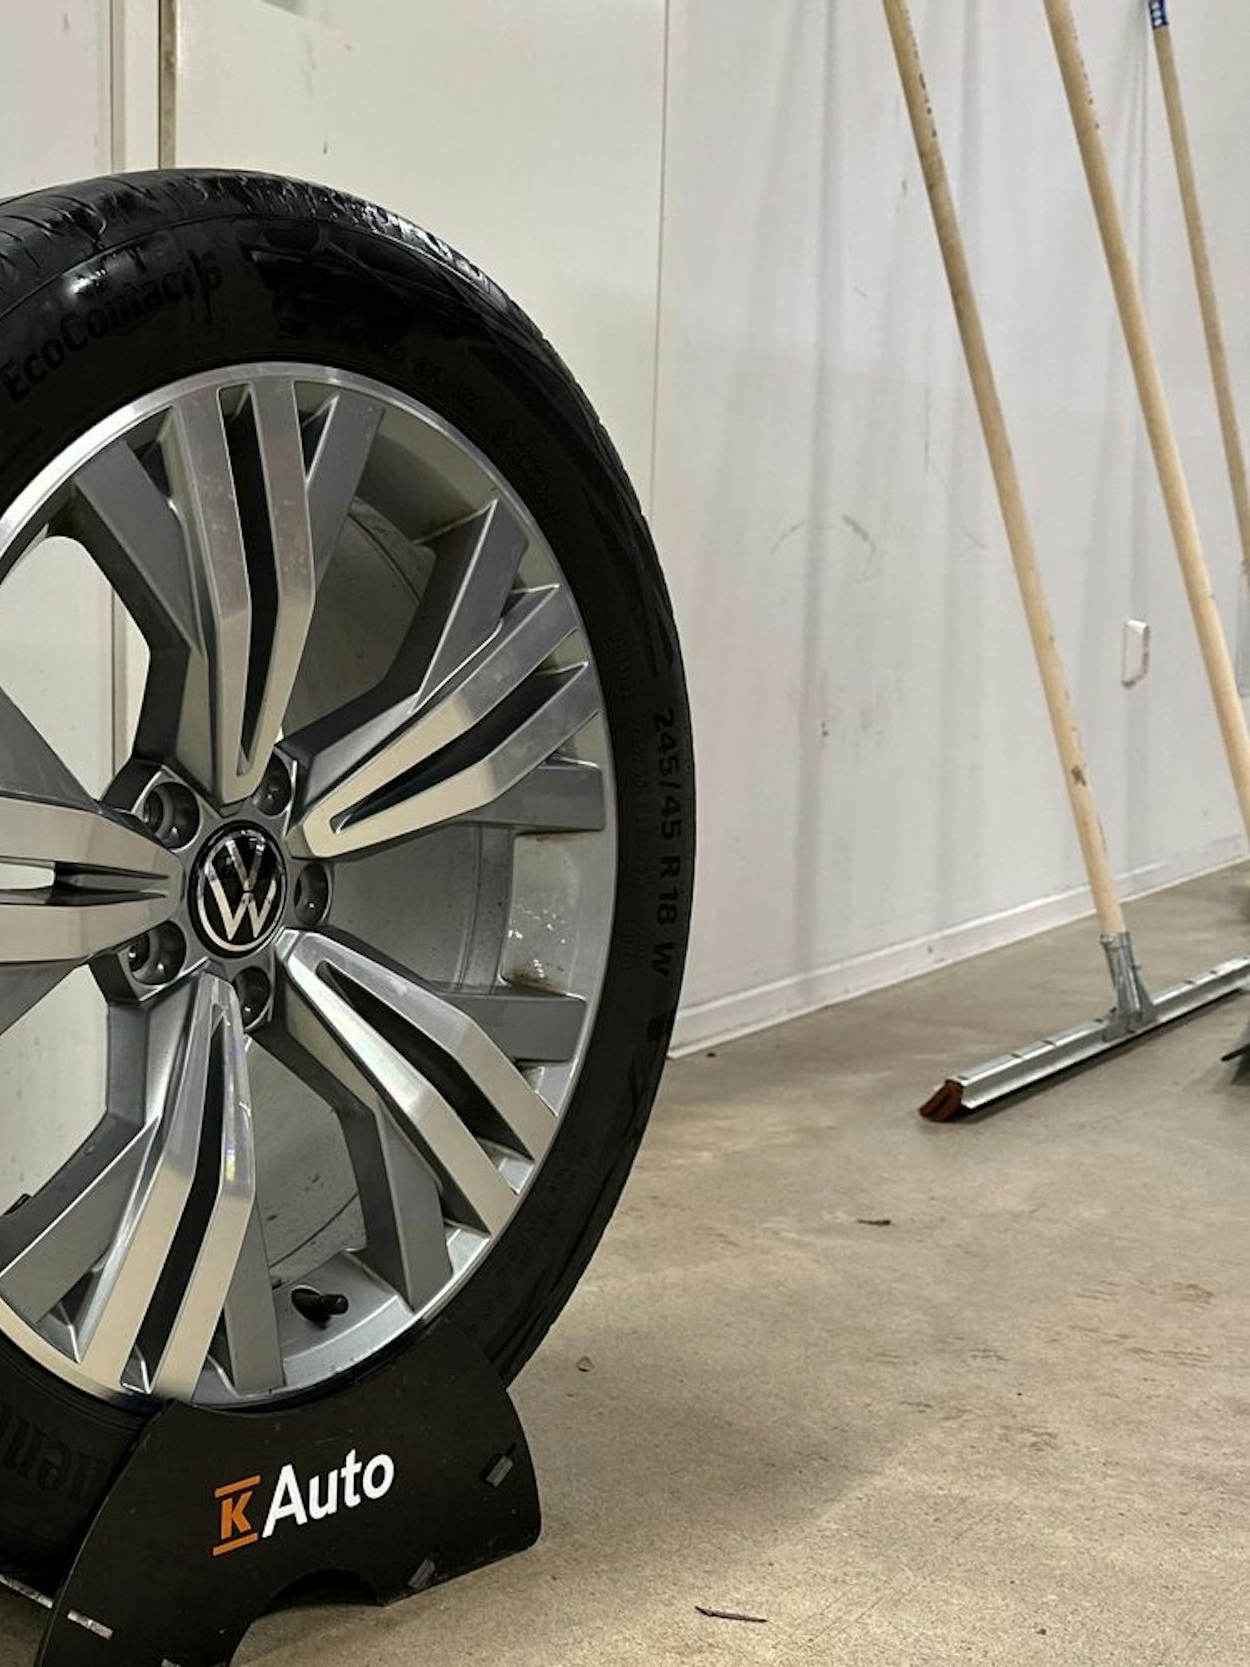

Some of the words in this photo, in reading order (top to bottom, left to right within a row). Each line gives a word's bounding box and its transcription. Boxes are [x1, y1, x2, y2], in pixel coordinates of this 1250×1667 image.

[654, 707, 682, 840] 245/45
[661, 856, 681, 878] R
[657, 888, 678, 926] 18
[652, 942, 674, 977] W
[260, 1447, 396, 1540] Auto
